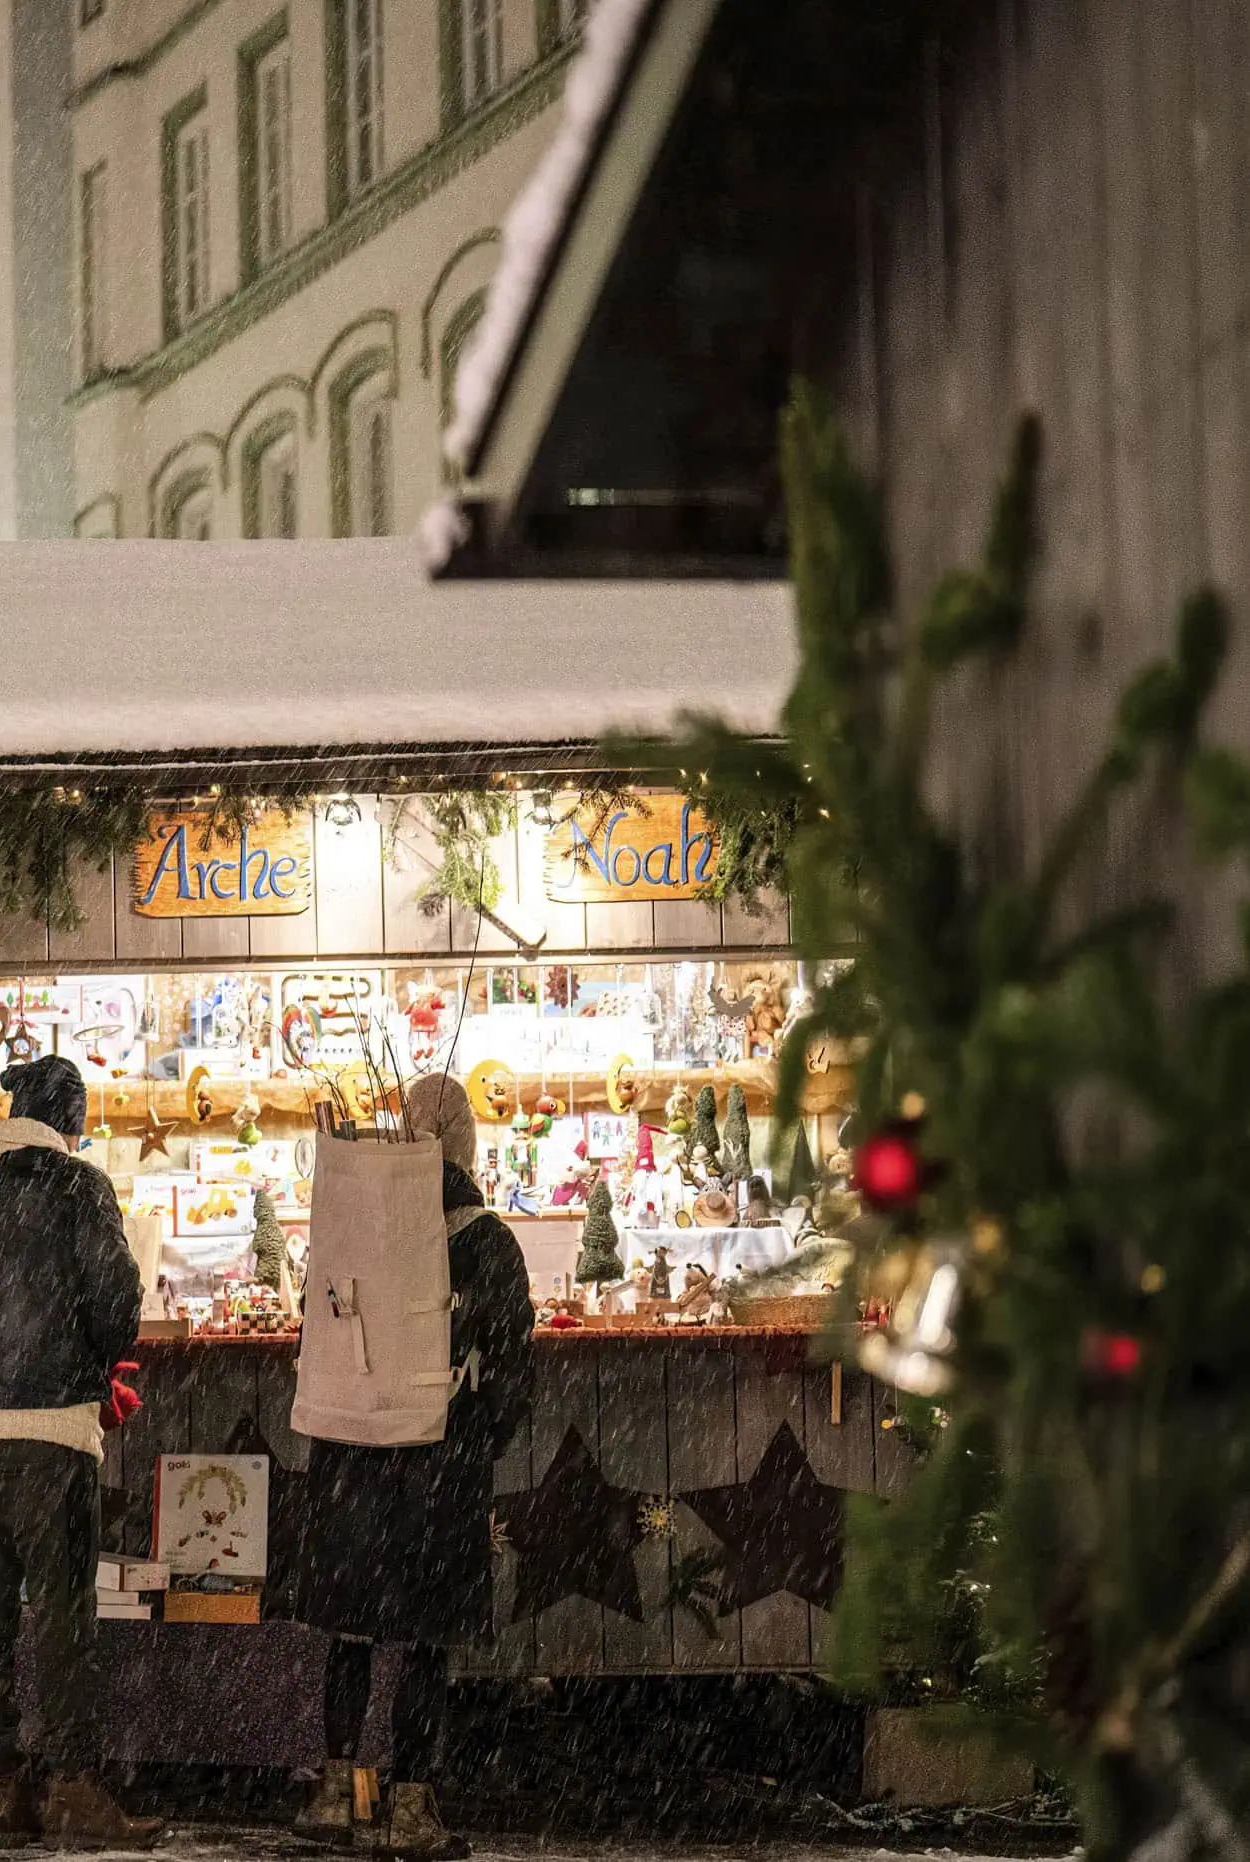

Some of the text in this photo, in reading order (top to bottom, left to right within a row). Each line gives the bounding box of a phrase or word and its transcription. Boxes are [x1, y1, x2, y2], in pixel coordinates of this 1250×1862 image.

[140, 824, 298, 904] Arche
[549, 800, 714, 888] Noah
[167, 1459, 191, 1471] goki
